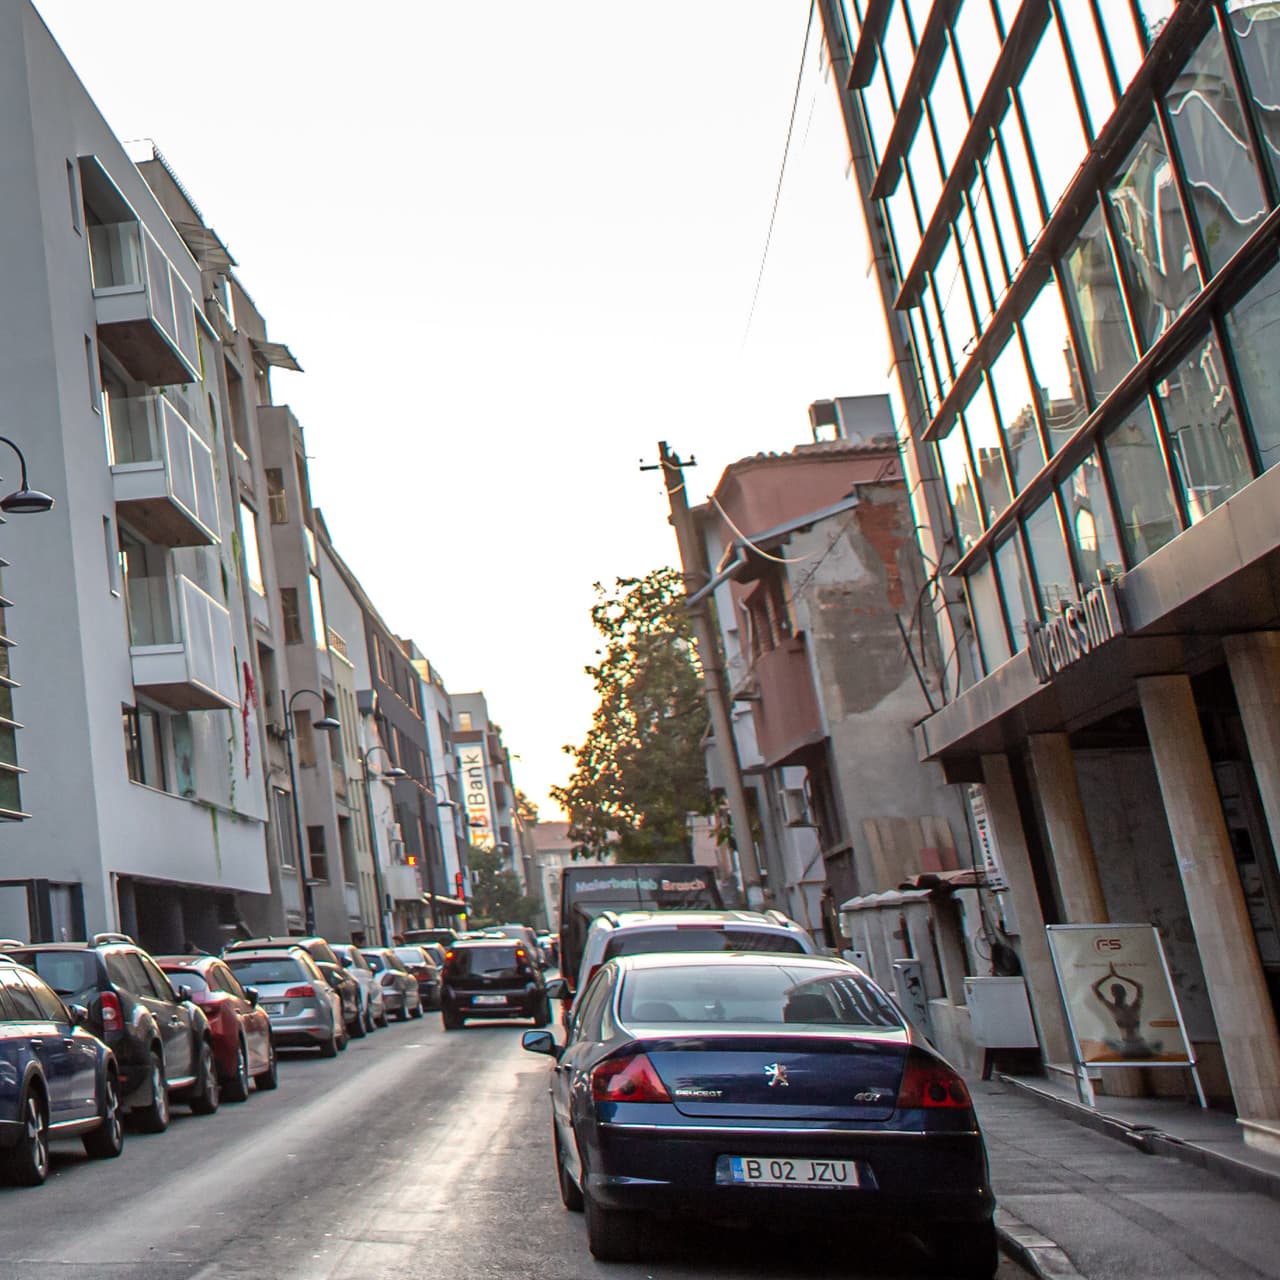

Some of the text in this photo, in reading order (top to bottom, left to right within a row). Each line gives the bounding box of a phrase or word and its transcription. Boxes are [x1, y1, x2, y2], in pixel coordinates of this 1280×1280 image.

[746, 1160, 848, 1182] B 02 JZU
